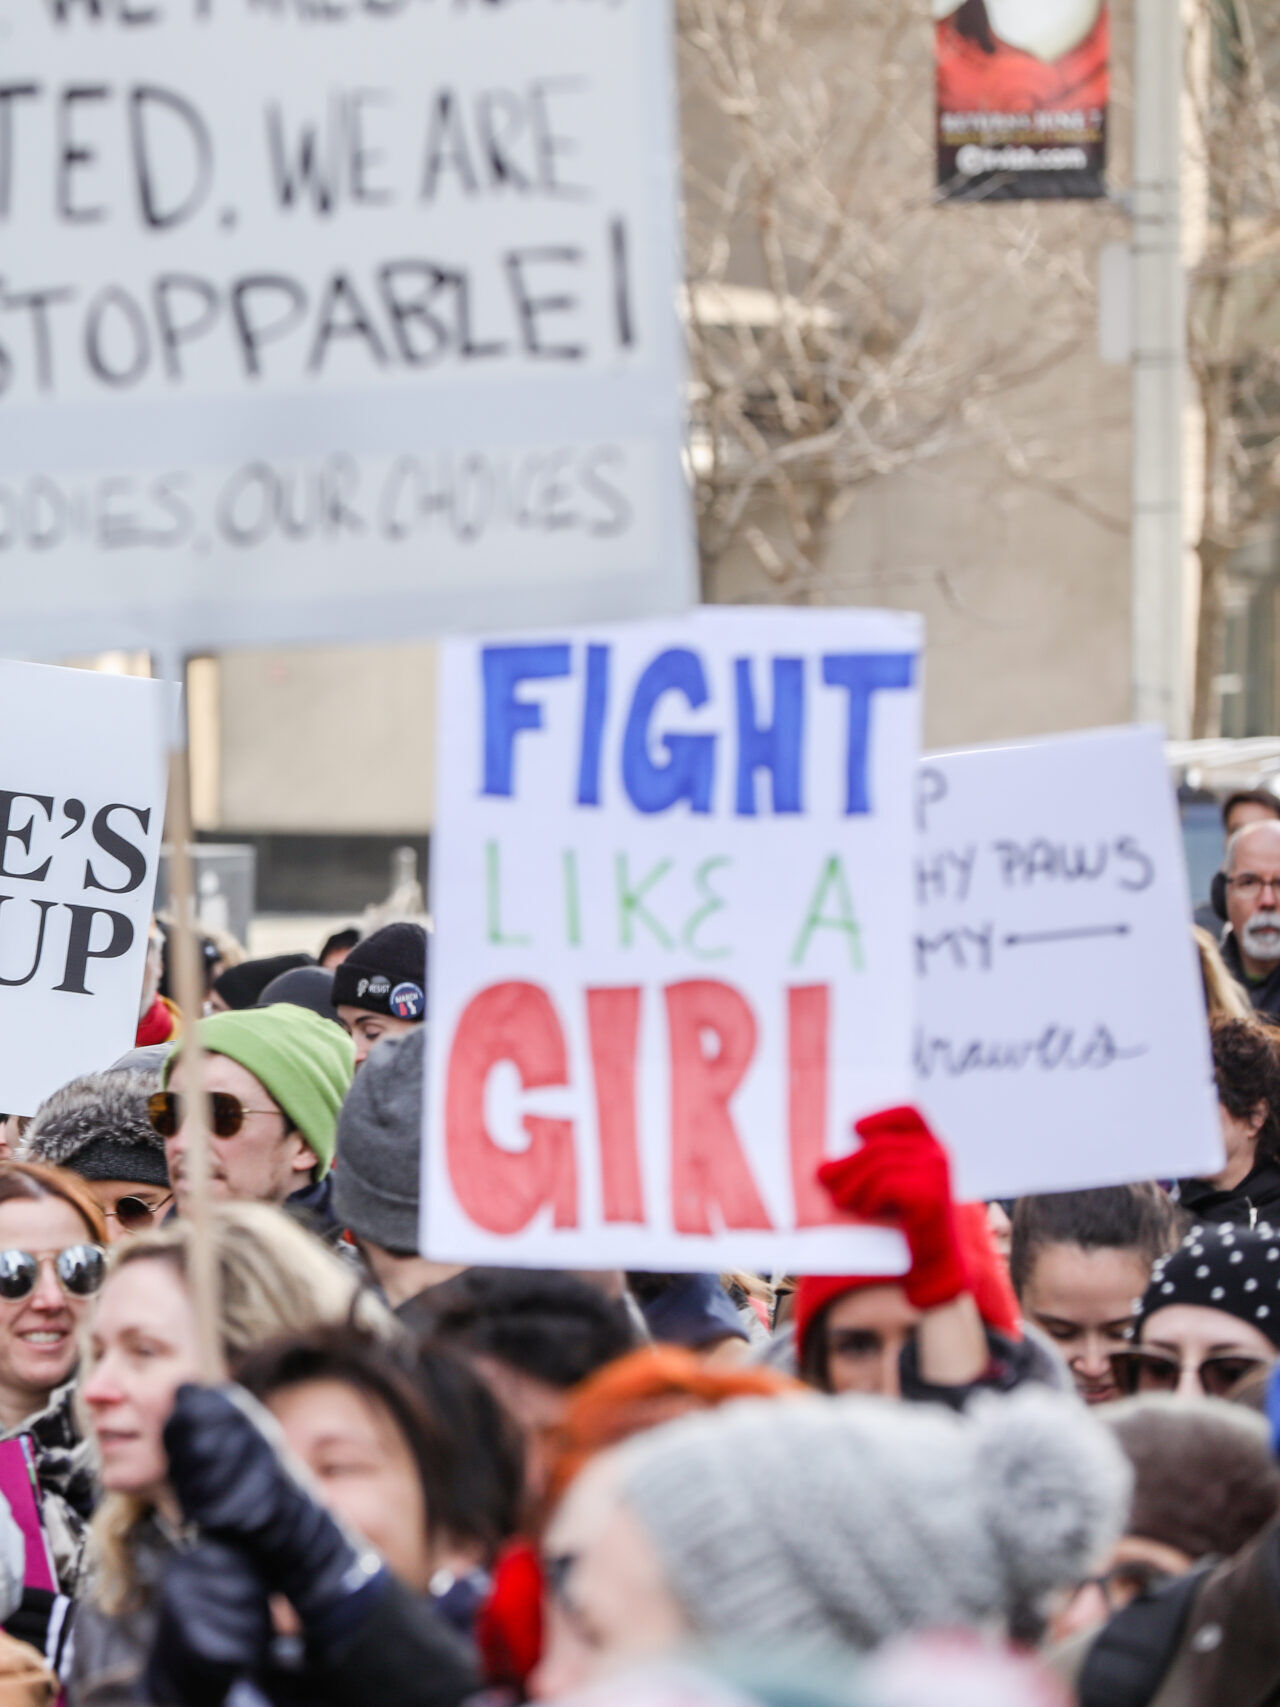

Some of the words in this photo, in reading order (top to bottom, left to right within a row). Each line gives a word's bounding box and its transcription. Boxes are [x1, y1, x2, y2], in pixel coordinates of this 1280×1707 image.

[264, 84, 398, 216] WE
[417, 76, 594, 208] ARE
[478, 641, 918, 818] FIGHT
[483, 837, 735, 962] LIKE
[787, 851, 866, 974] A
[994, 834, 1156, 893] PAWS
[369, 983, 391, 994] RESIST
[443, 977, 902, 1237] GIRL
